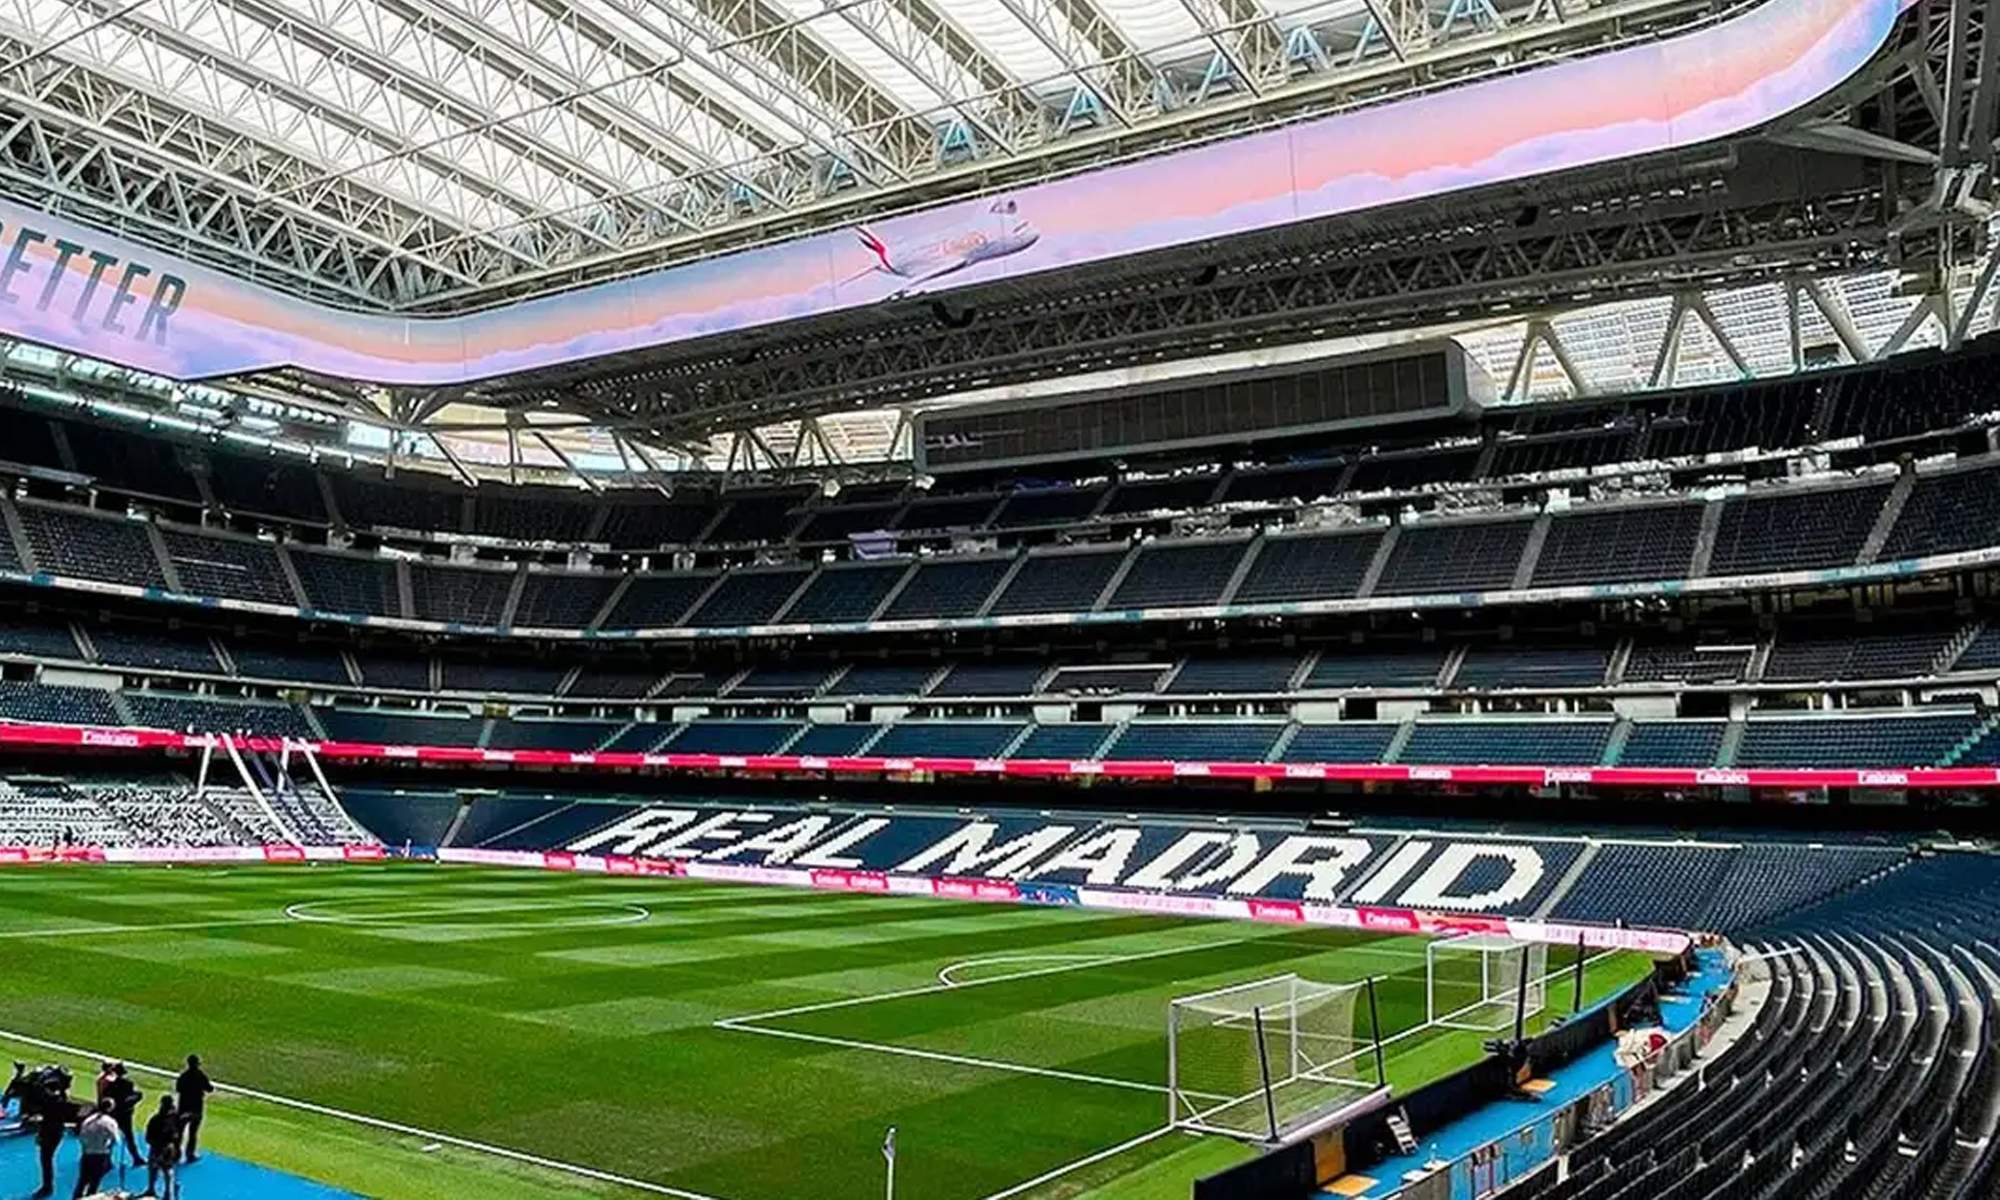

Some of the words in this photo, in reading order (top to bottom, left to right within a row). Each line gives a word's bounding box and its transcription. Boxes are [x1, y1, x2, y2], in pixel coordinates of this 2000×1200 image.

[0, 218, 187, 347] ETTER
[565, 808, 890, 868] REAL
[889, 821, 1545, 912] MADRID
